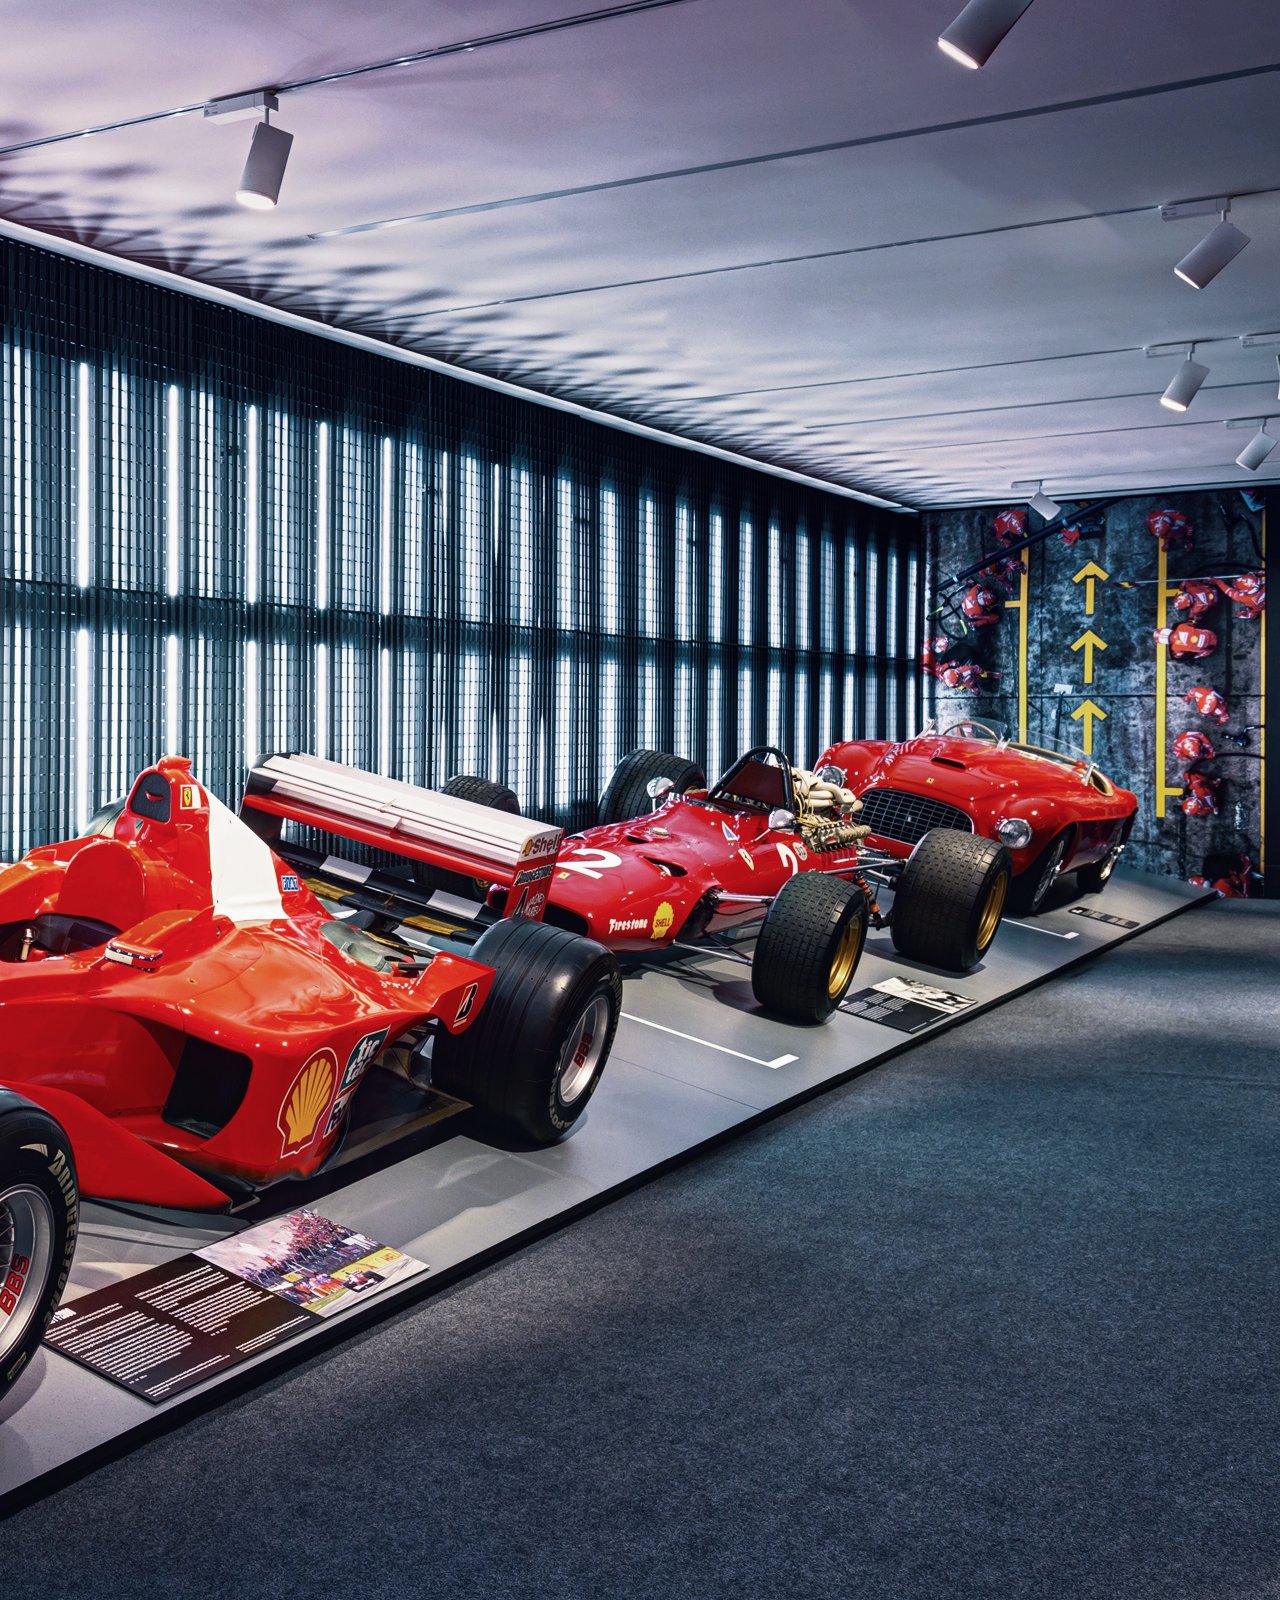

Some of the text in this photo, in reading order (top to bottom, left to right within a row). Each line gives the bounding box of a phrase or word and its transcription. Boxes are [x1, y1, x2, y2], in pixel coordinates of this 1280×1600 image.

[556, 848, 623, 879] 2
[608, 918, 648, 935] Firestone
[655, 918, 671, 928] SHELL
[357, 1036, 380, 1062] tic
